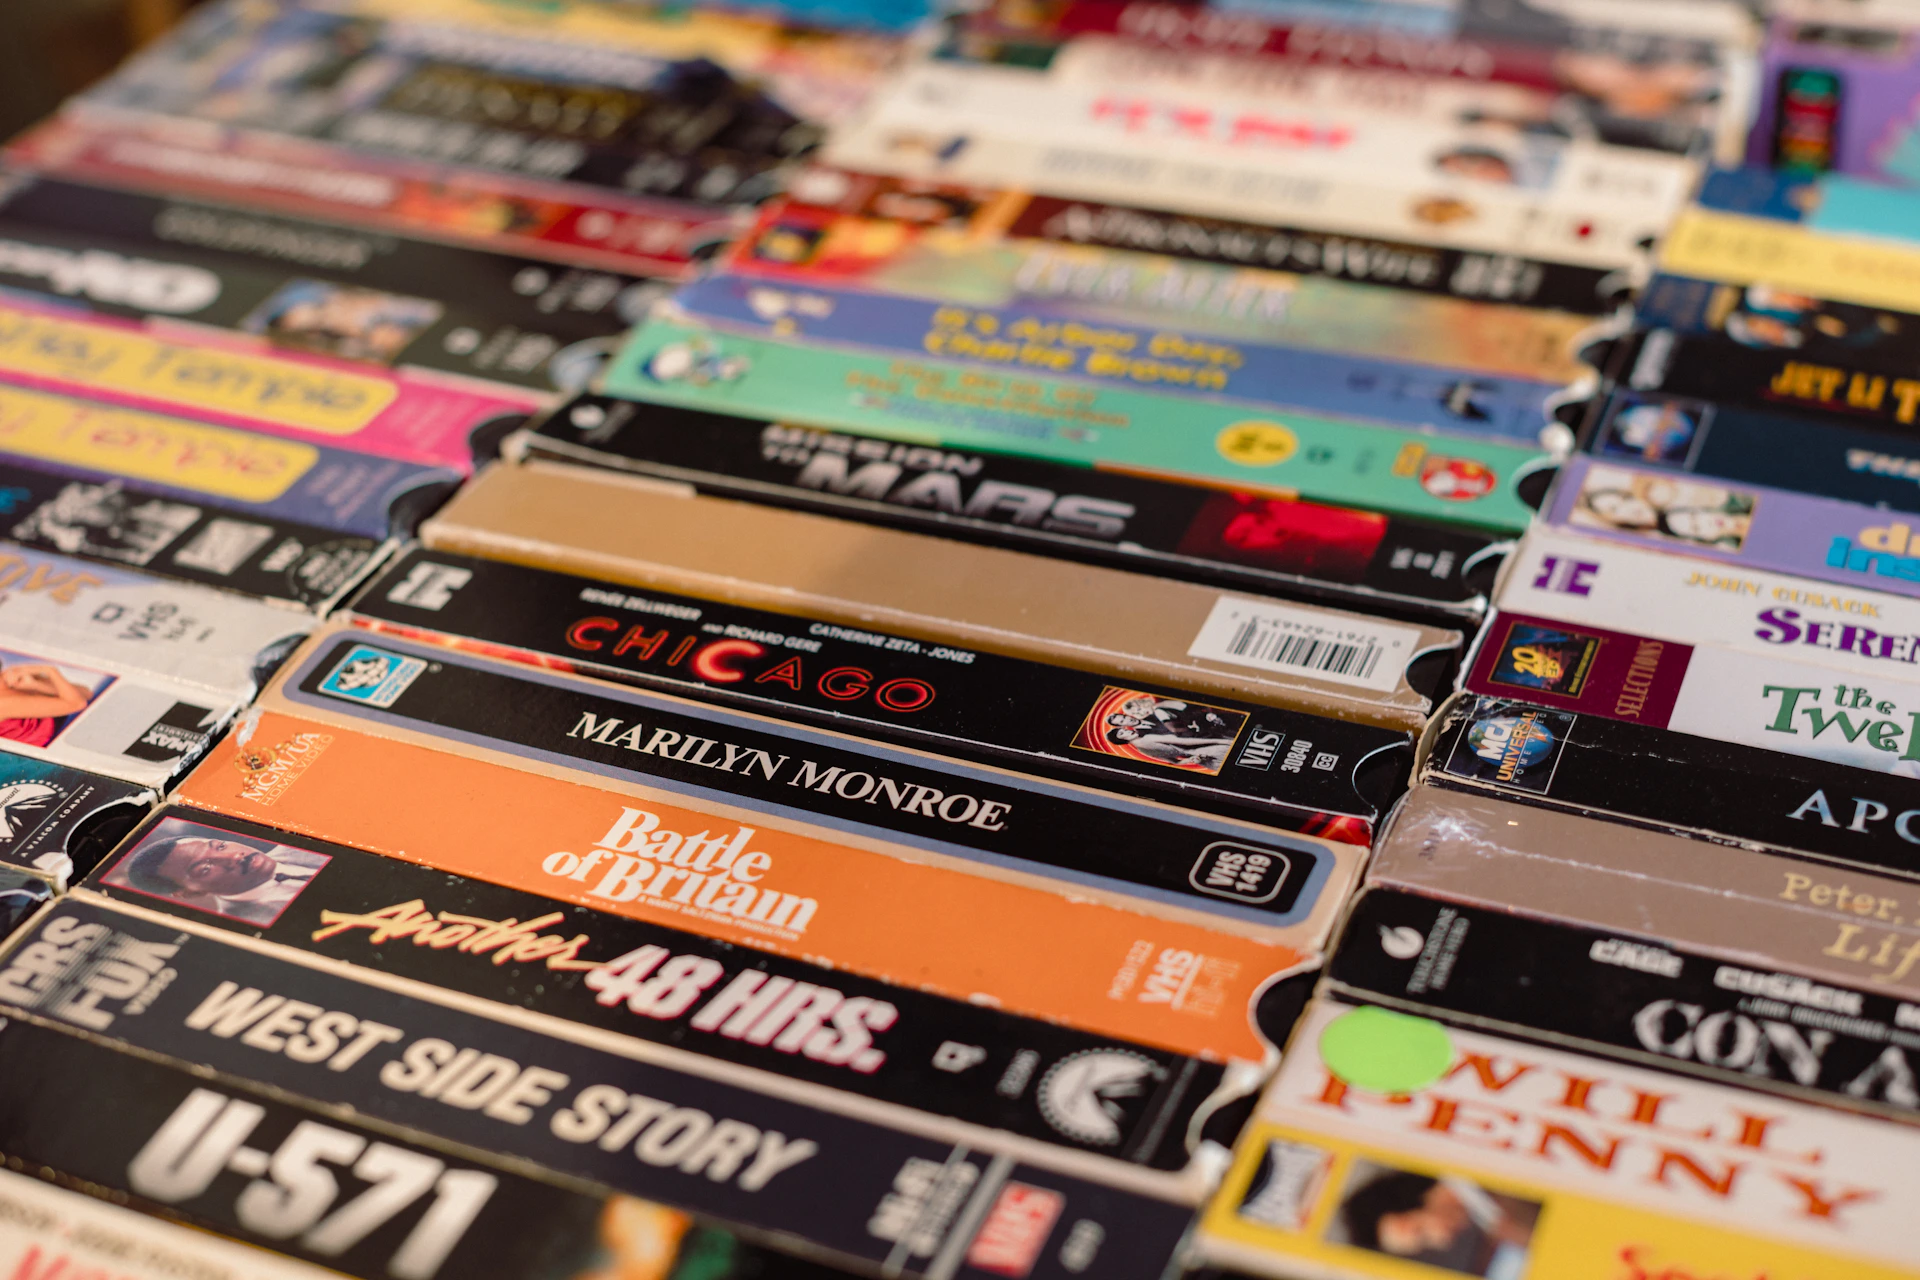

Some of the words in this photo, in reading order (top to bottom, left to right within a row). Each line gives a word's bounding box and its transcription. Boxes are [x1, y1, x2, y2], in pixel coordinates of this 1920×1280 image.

[761, 423, 984, 477] MISSION
[796, 452, 1136, 538] MARS
[1684, 570, 1761, 598] JOHN
[1770, 584, 1884, 619] CUSACK
[565, 614, 937, 713] CHICAGO
[723, 623, 785, 646] RICHARD
[783, 634, 823, 654] GERE
[808, 622, 887, 648] CATHERINE
[884, 636, 921, 655] ZETA
[926, 645, 977, 665] JONES
[1614, 638, 1665, 719] SELECTIONS
[1833, 683, 1897, 716] the
[240, 732, 321, 803] MGM/UA
[261, 770, 299, 807] HOME
[296, 734, 334, 769] VIDEO
[565, 710, 790, 781] MARILYN
[787, 758, 1013, 832] MONROE
[1239, 730, 1281, 766] VHS
[1280, 739, 1314, 774] 30840
[1475, 716, 1518, 761] MCA
[1495, 710, 1538, 782] UNIVERSAL
[26, 820, 60, 850] VIACOM
[59, 785, 95, 819] COMPANY
[591, 806, 773, 883] Battle
[541, 848, 614, 882] of
[586, 852, 819, 934] Britain
[1204, 850, 1247, 887] VHS
[1234, 853, 1272, 892] 1419
[0, 915, 113, 1009] CBS
[50, 930, 182, 1032] FOX
[121, 966, 179, 1016] VIDEO
[311, 897, 608, 972] Another
[584, 943, 724, 1021] 48
[690, 967, 899, 1075] HRS.
[1136, 947, 1195, 1003] VHS
[1631, 999, 1836, 1087] CON
[183, 980, 404, 1074] WEST
[380, 1036, 570, 1127] SIDE
[550, 1083, 819, 1193] STORY
[127, 1085, 500, 1280] U-571
